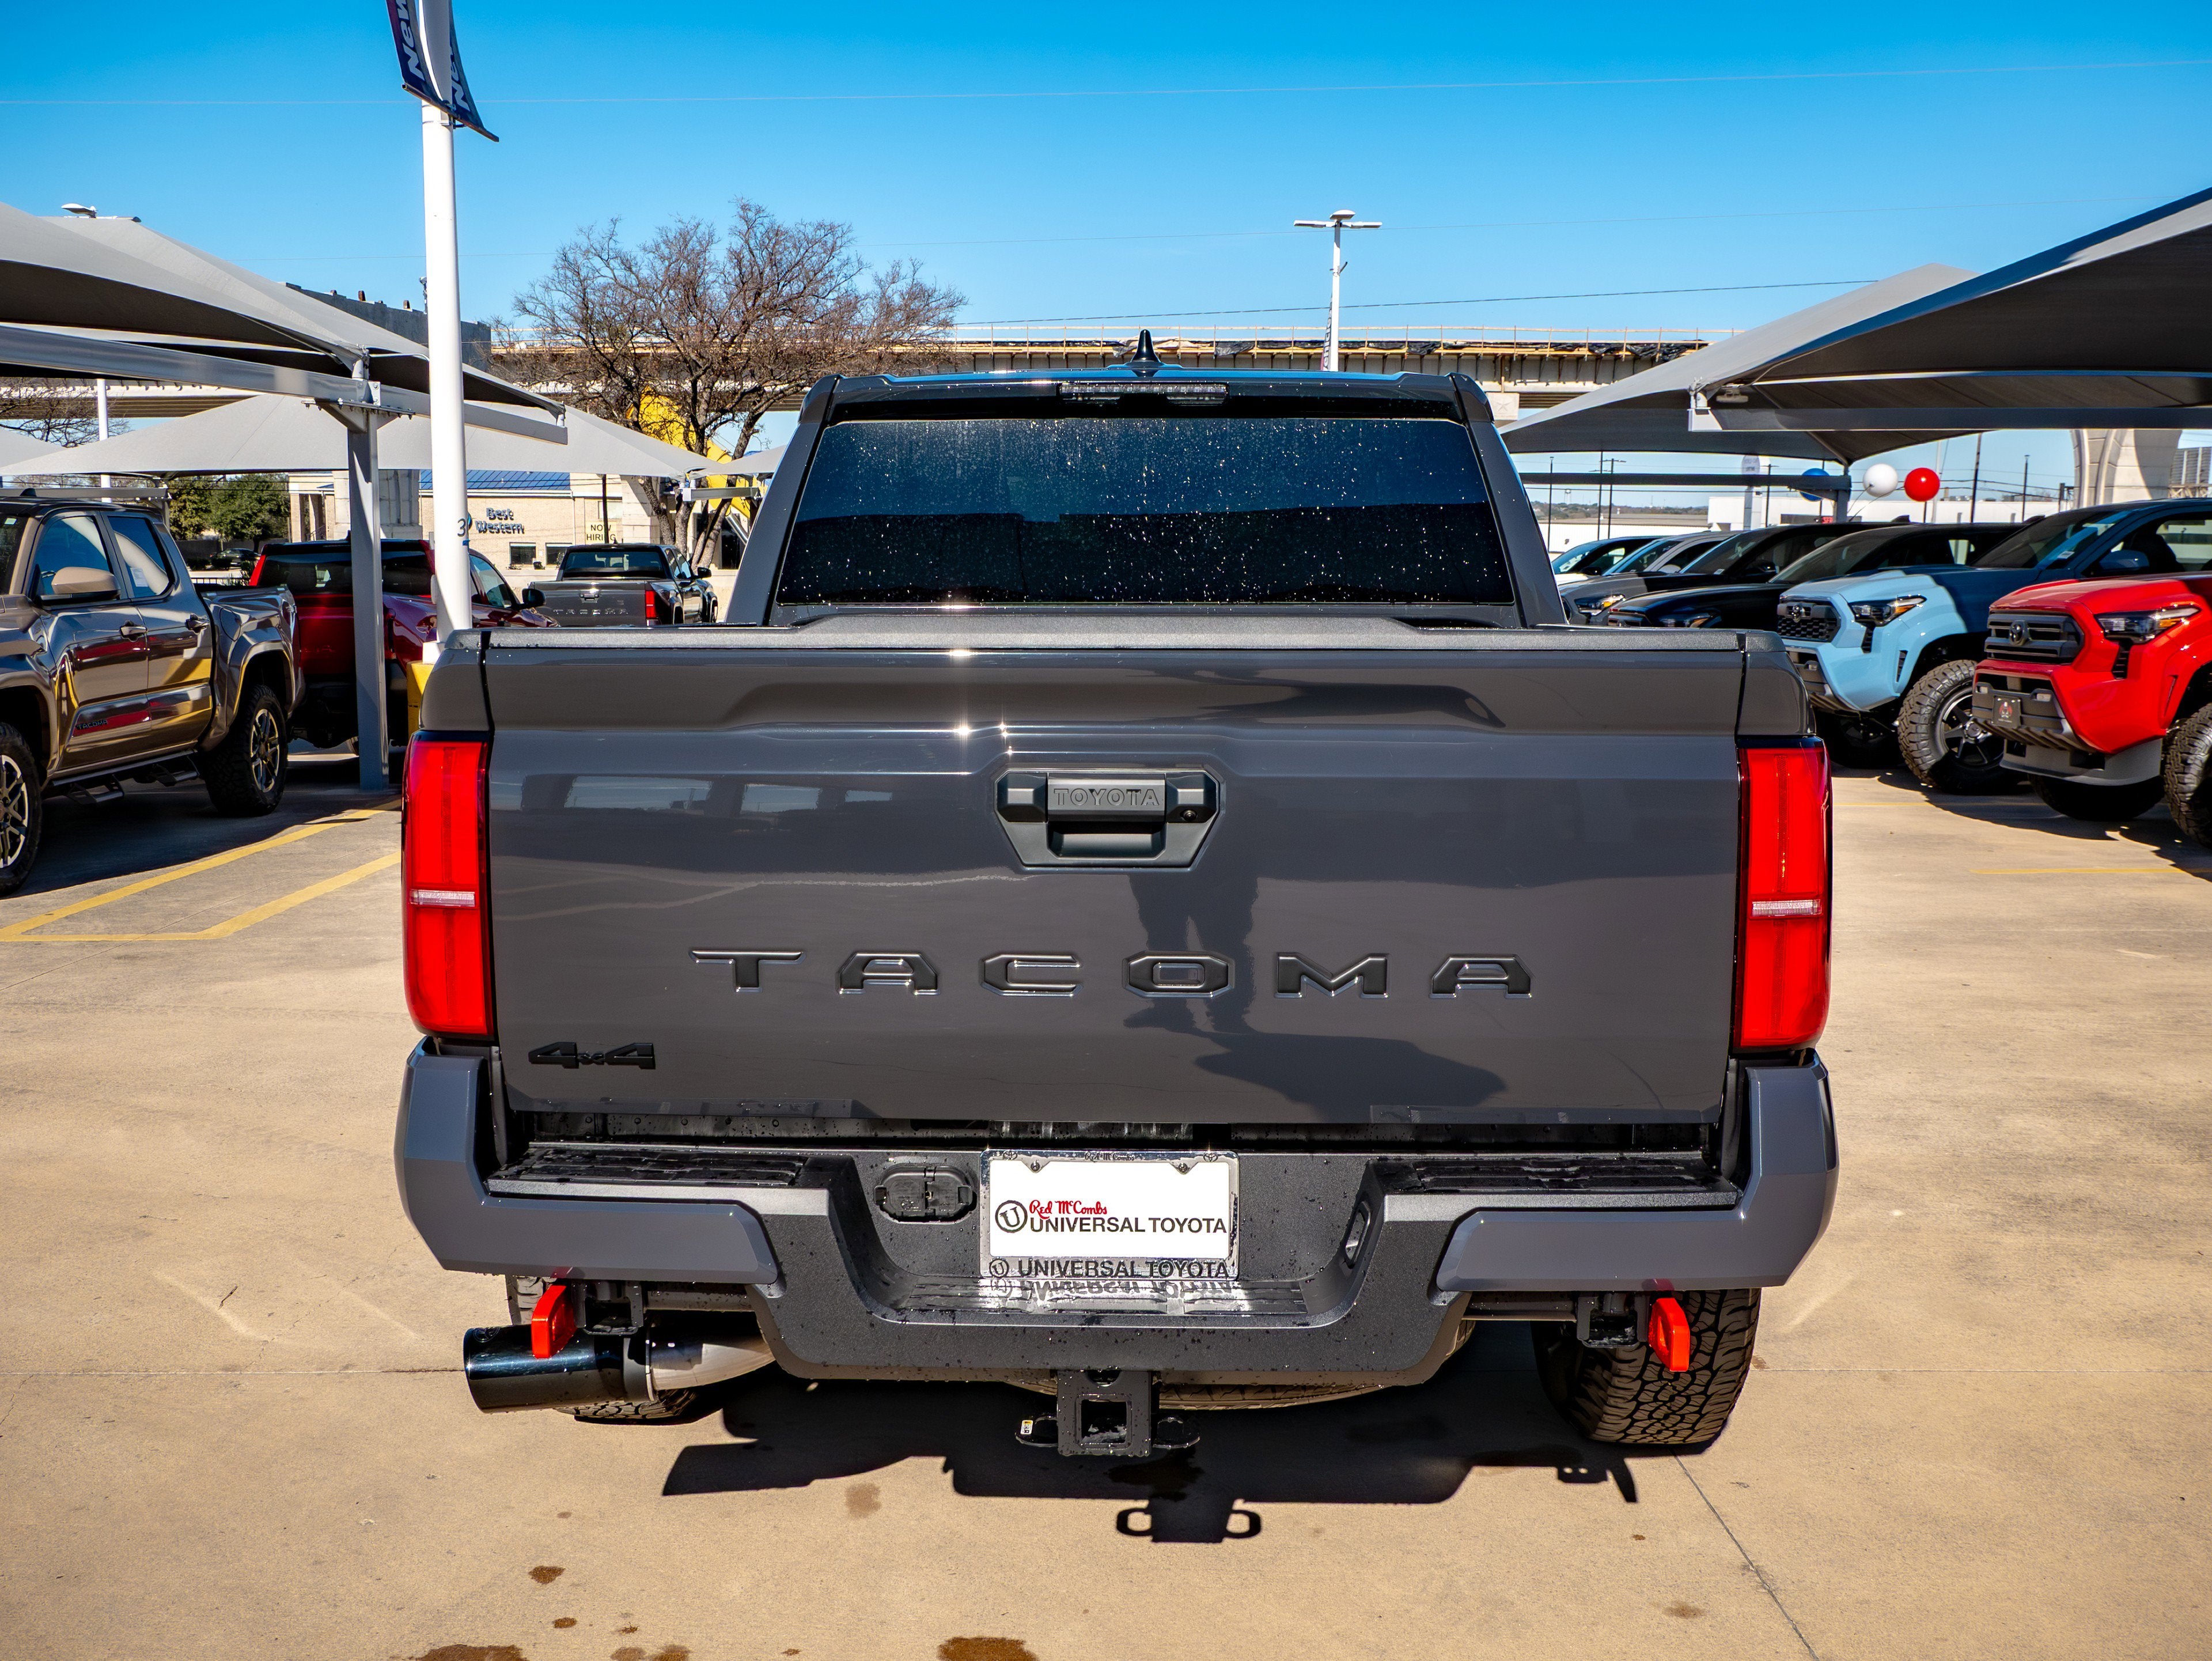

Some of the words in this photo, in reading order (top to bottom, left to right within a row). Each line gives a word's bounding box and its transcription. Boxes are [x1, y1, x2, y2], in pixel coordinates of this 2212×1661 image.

[486, 508, 513, 520] Best
[457, 519, 466, 537] 3
[475, 520, 524, 534] Western
[1054, 788, 1160, 807] TOYOTA
[690, 949, 1535, 998] TACOMA
[1029, 1200, 1053, 1220] Red
[1055, 1201, 1108, 1214] McCombs
[1030, 1217, 1146, 1232] UNIVERSAL
[1148, 1217, 1228, 1234] TOYOTA
[1018, 1259, 1142, 1278] UNIVERSAL
[1145, 1260, 1230, 1278] TOYOTA
